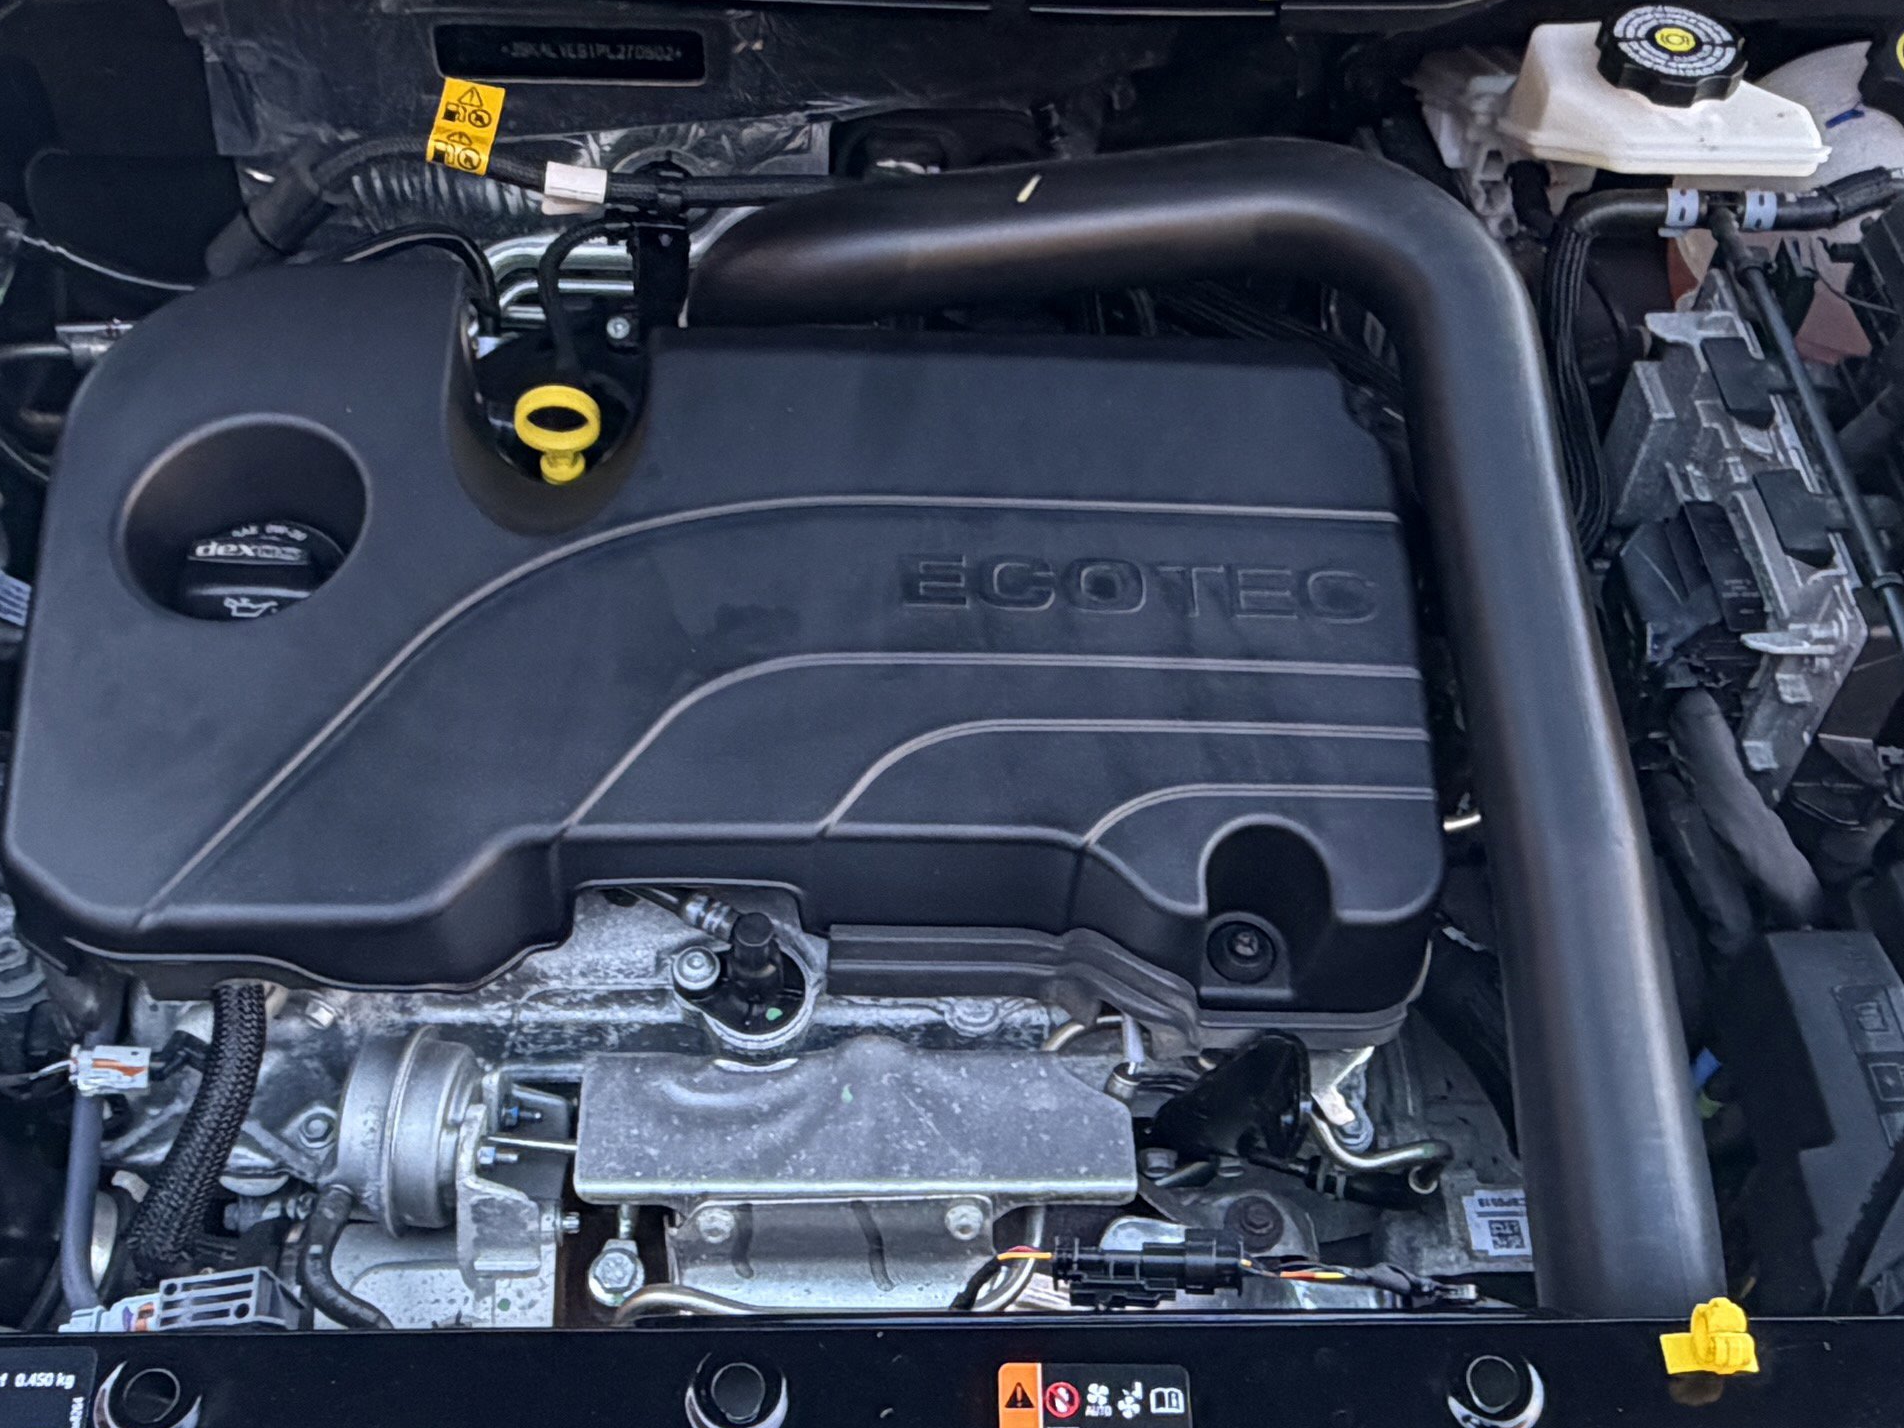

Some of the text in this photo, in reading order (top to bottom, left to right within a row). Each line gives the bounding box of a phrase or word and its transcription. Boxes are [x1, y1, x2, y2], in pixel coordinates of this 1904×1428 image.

[899, 556, 1380, 625] ECOTEC
[14, 1372, 54, 1388] 0.450
[55, 1372, 76, 1390] kg
[1085, 1405, 1113, 1417] AUTO
